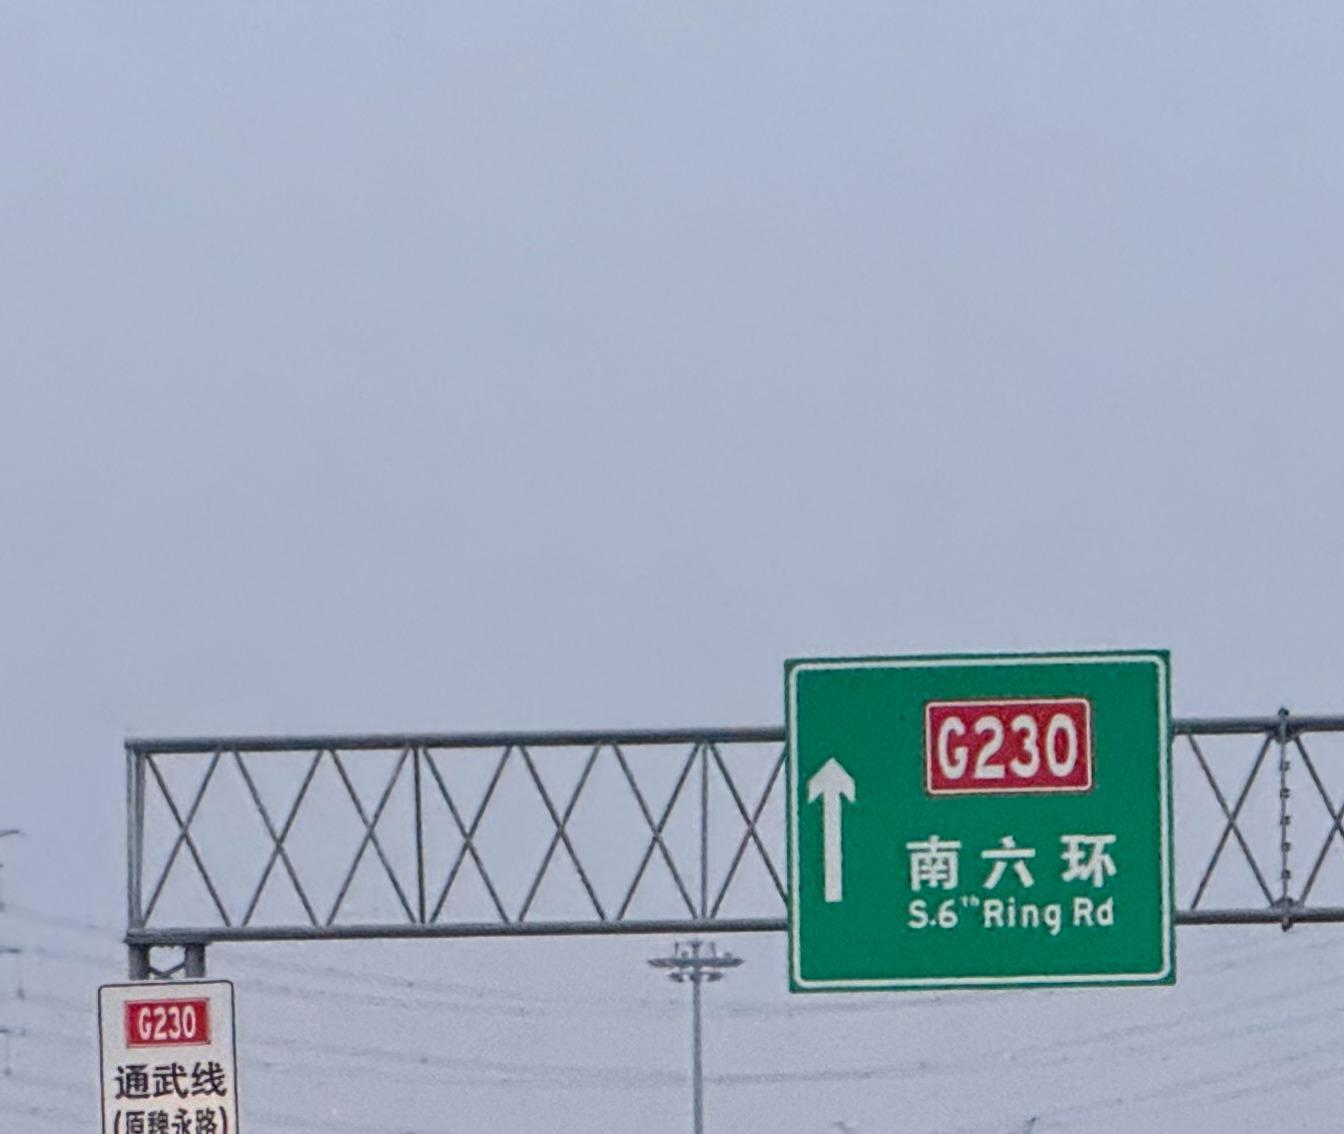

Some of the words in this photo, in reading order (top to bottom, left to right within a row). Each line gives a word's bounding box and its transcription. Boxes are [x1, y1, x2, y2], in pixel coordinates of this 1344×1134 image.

[938, 714, 1078, 779] G230
[906, 835, 1116, 890] 南六环
[983, 897, 1061, 936] Ring
[1073, 896, 1114, 926] Rd
[138, 1005, 196, 1040] G230
[115, 1062, 227, 1099] 通武线
